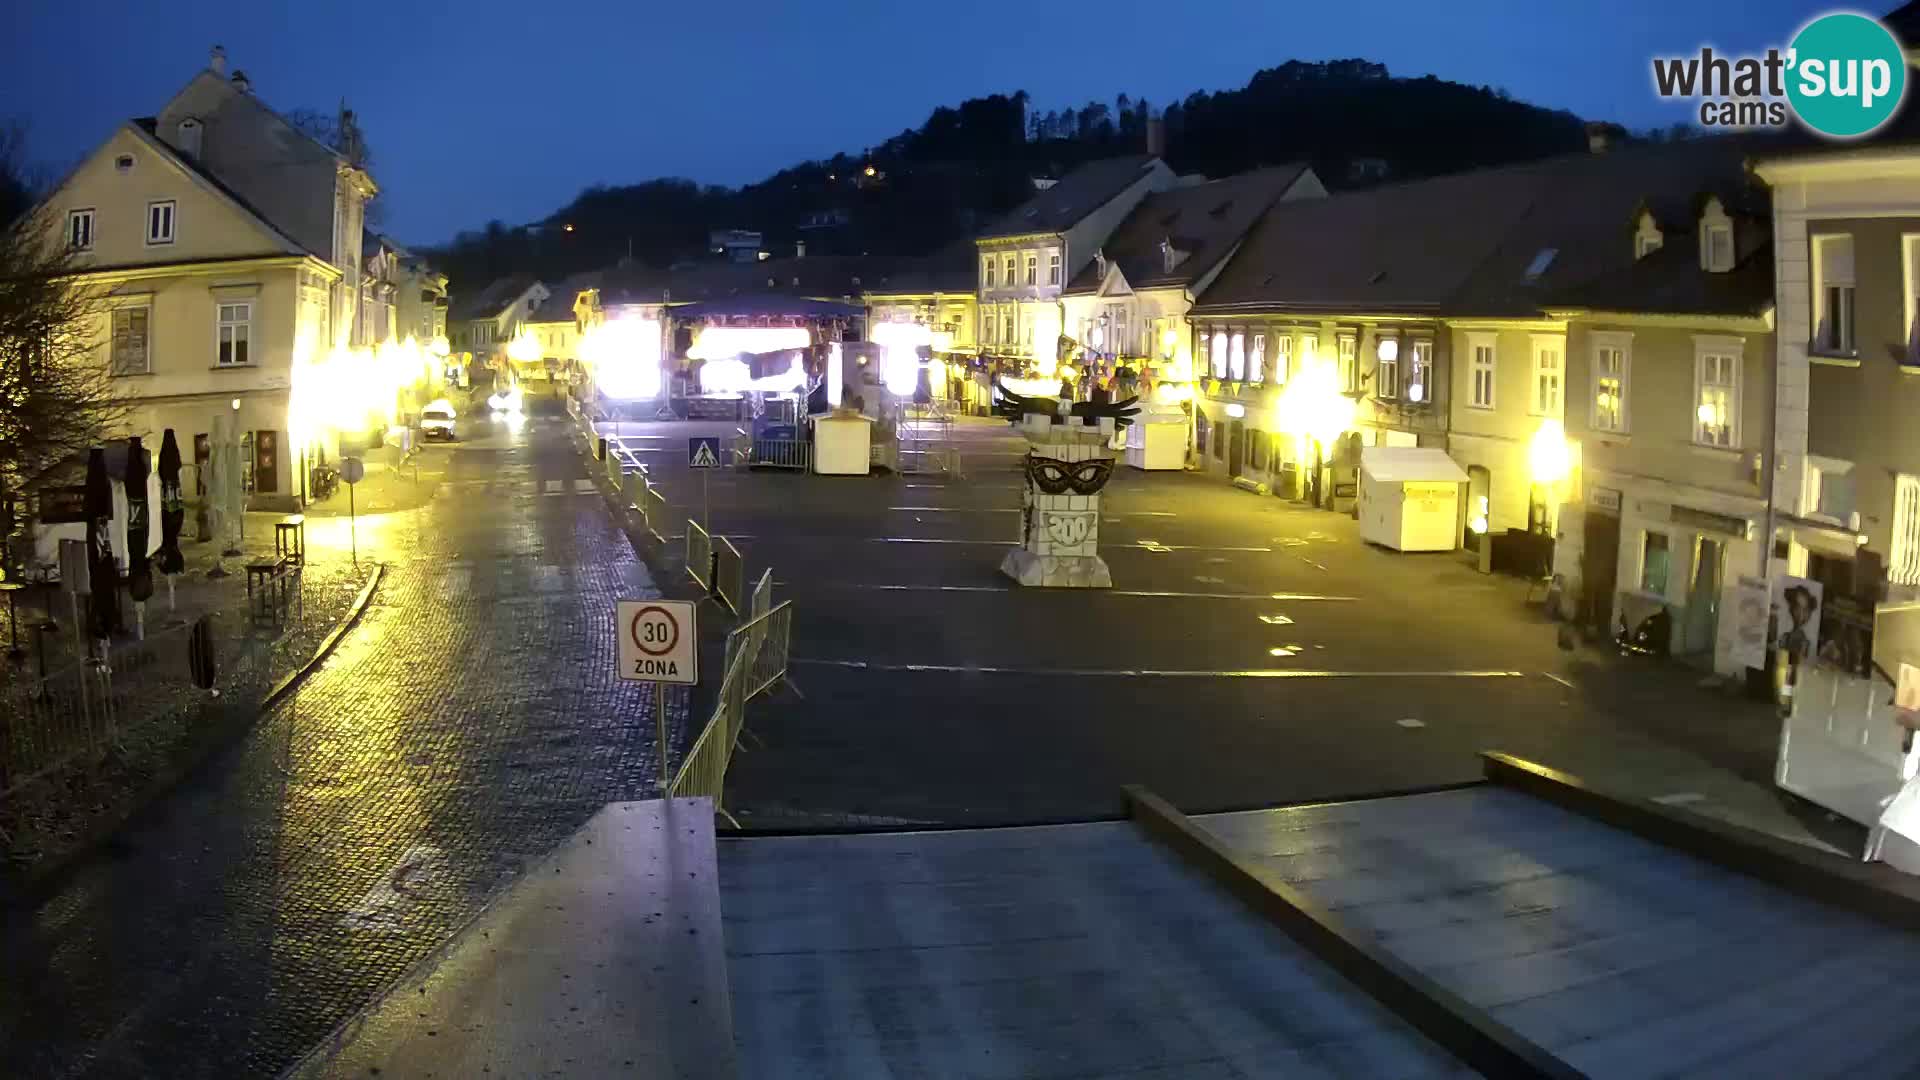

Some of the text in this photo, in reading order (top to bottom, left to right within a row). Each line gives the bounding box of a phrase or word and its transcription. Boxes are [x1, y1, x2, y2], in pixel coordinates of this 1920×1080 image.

[1049, 516, 1087, 546] 200
[644, 622, 668, 643] 30
[635, 660, 679, 676] ZONA
